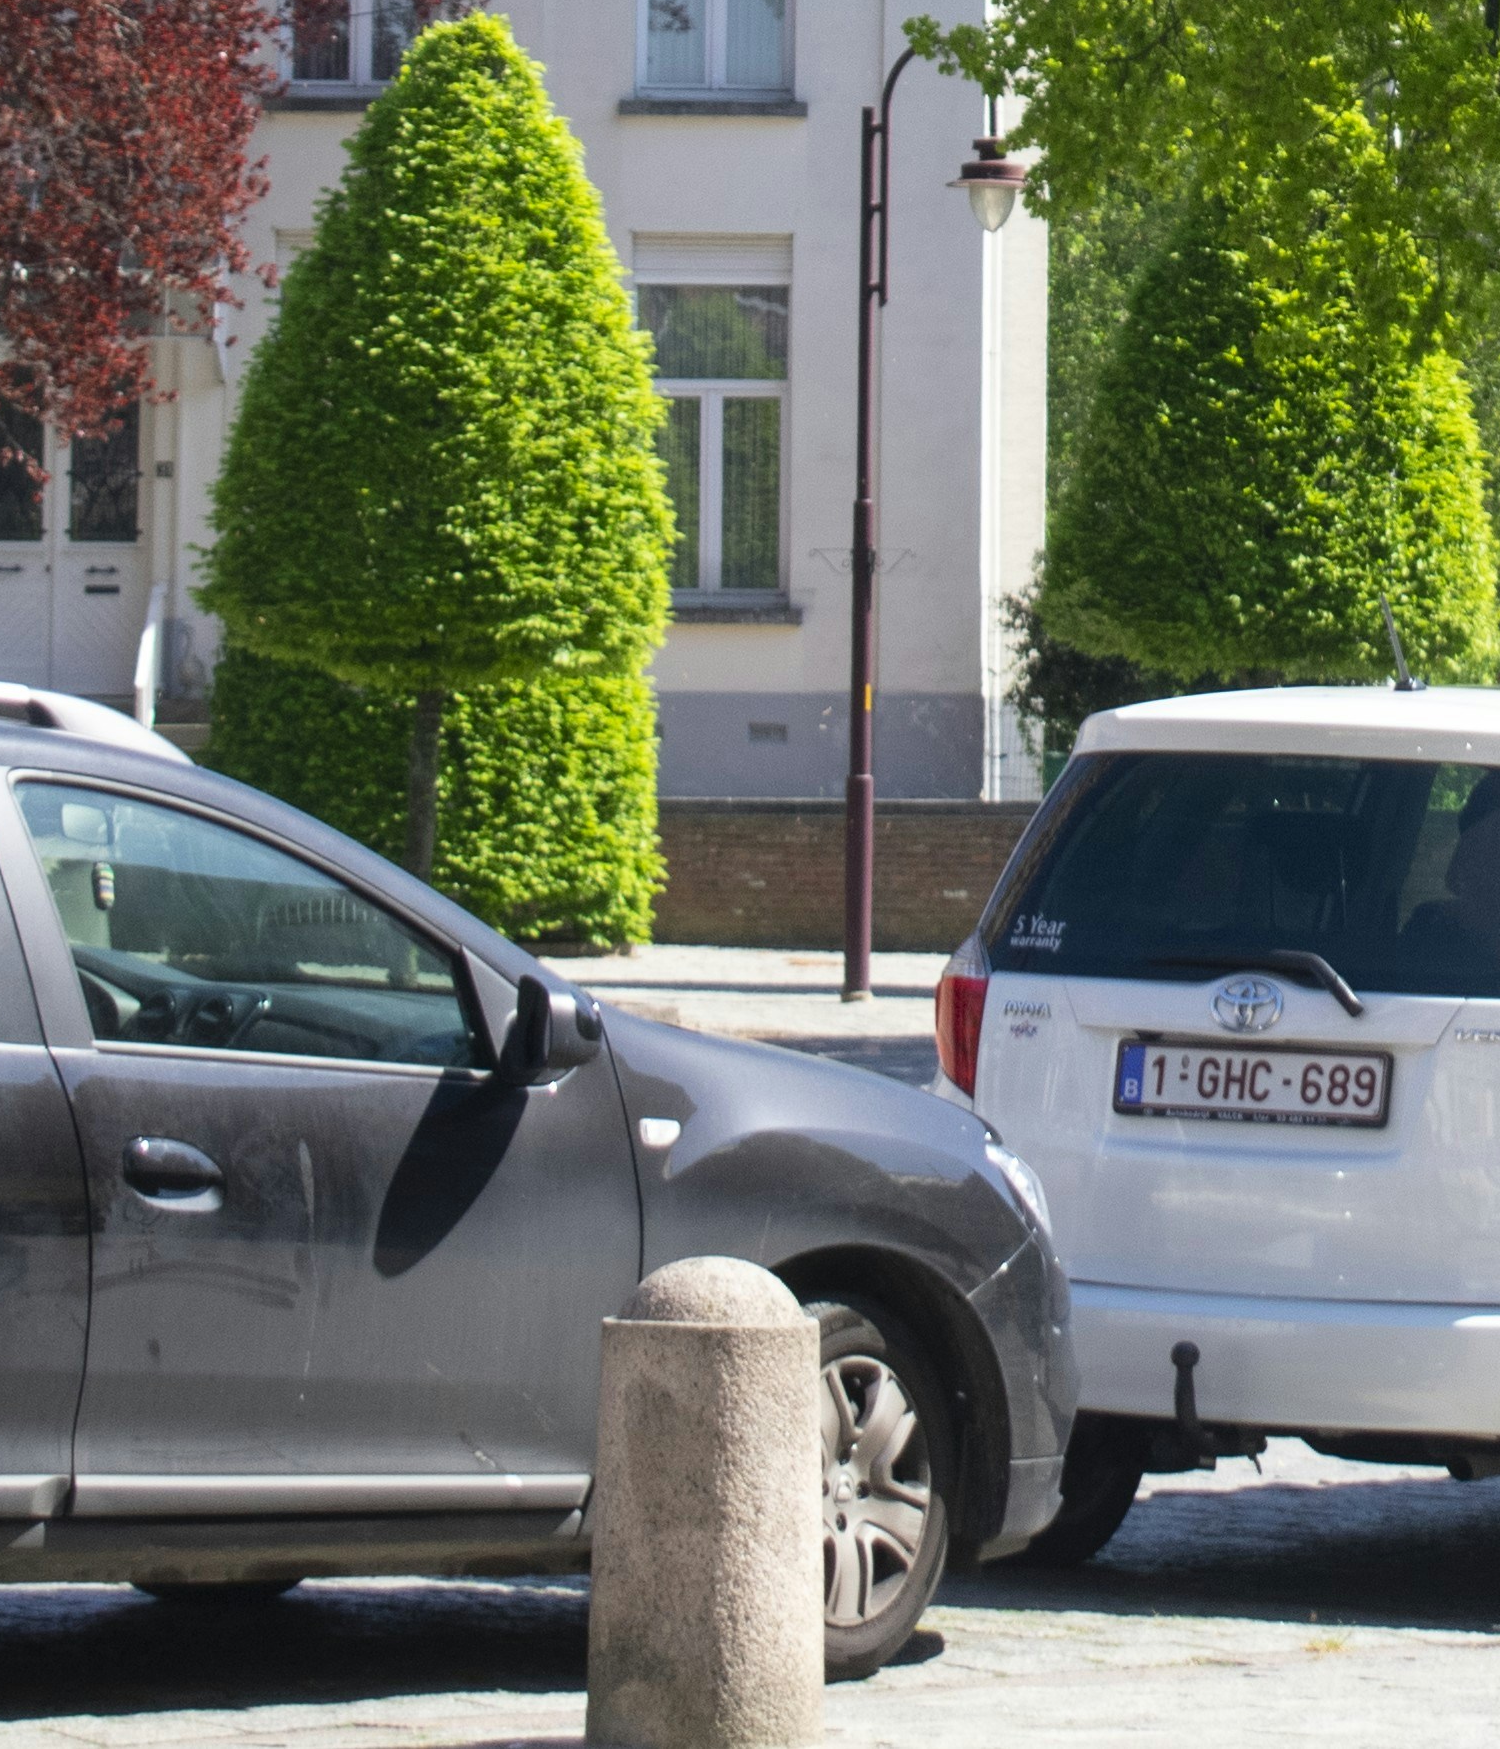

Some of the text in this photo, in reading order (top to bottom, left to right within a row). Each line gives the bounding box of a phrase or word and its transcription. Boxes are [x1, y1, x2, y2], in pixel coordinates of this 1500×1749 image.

[1013, 912, 1066, 935] 5 Year
[1010, 935, 1062, 951] warranty
[1124, 1077, 1138, 1098] B
[1152, 1054, 1377, 1108] 1-GHC-689
